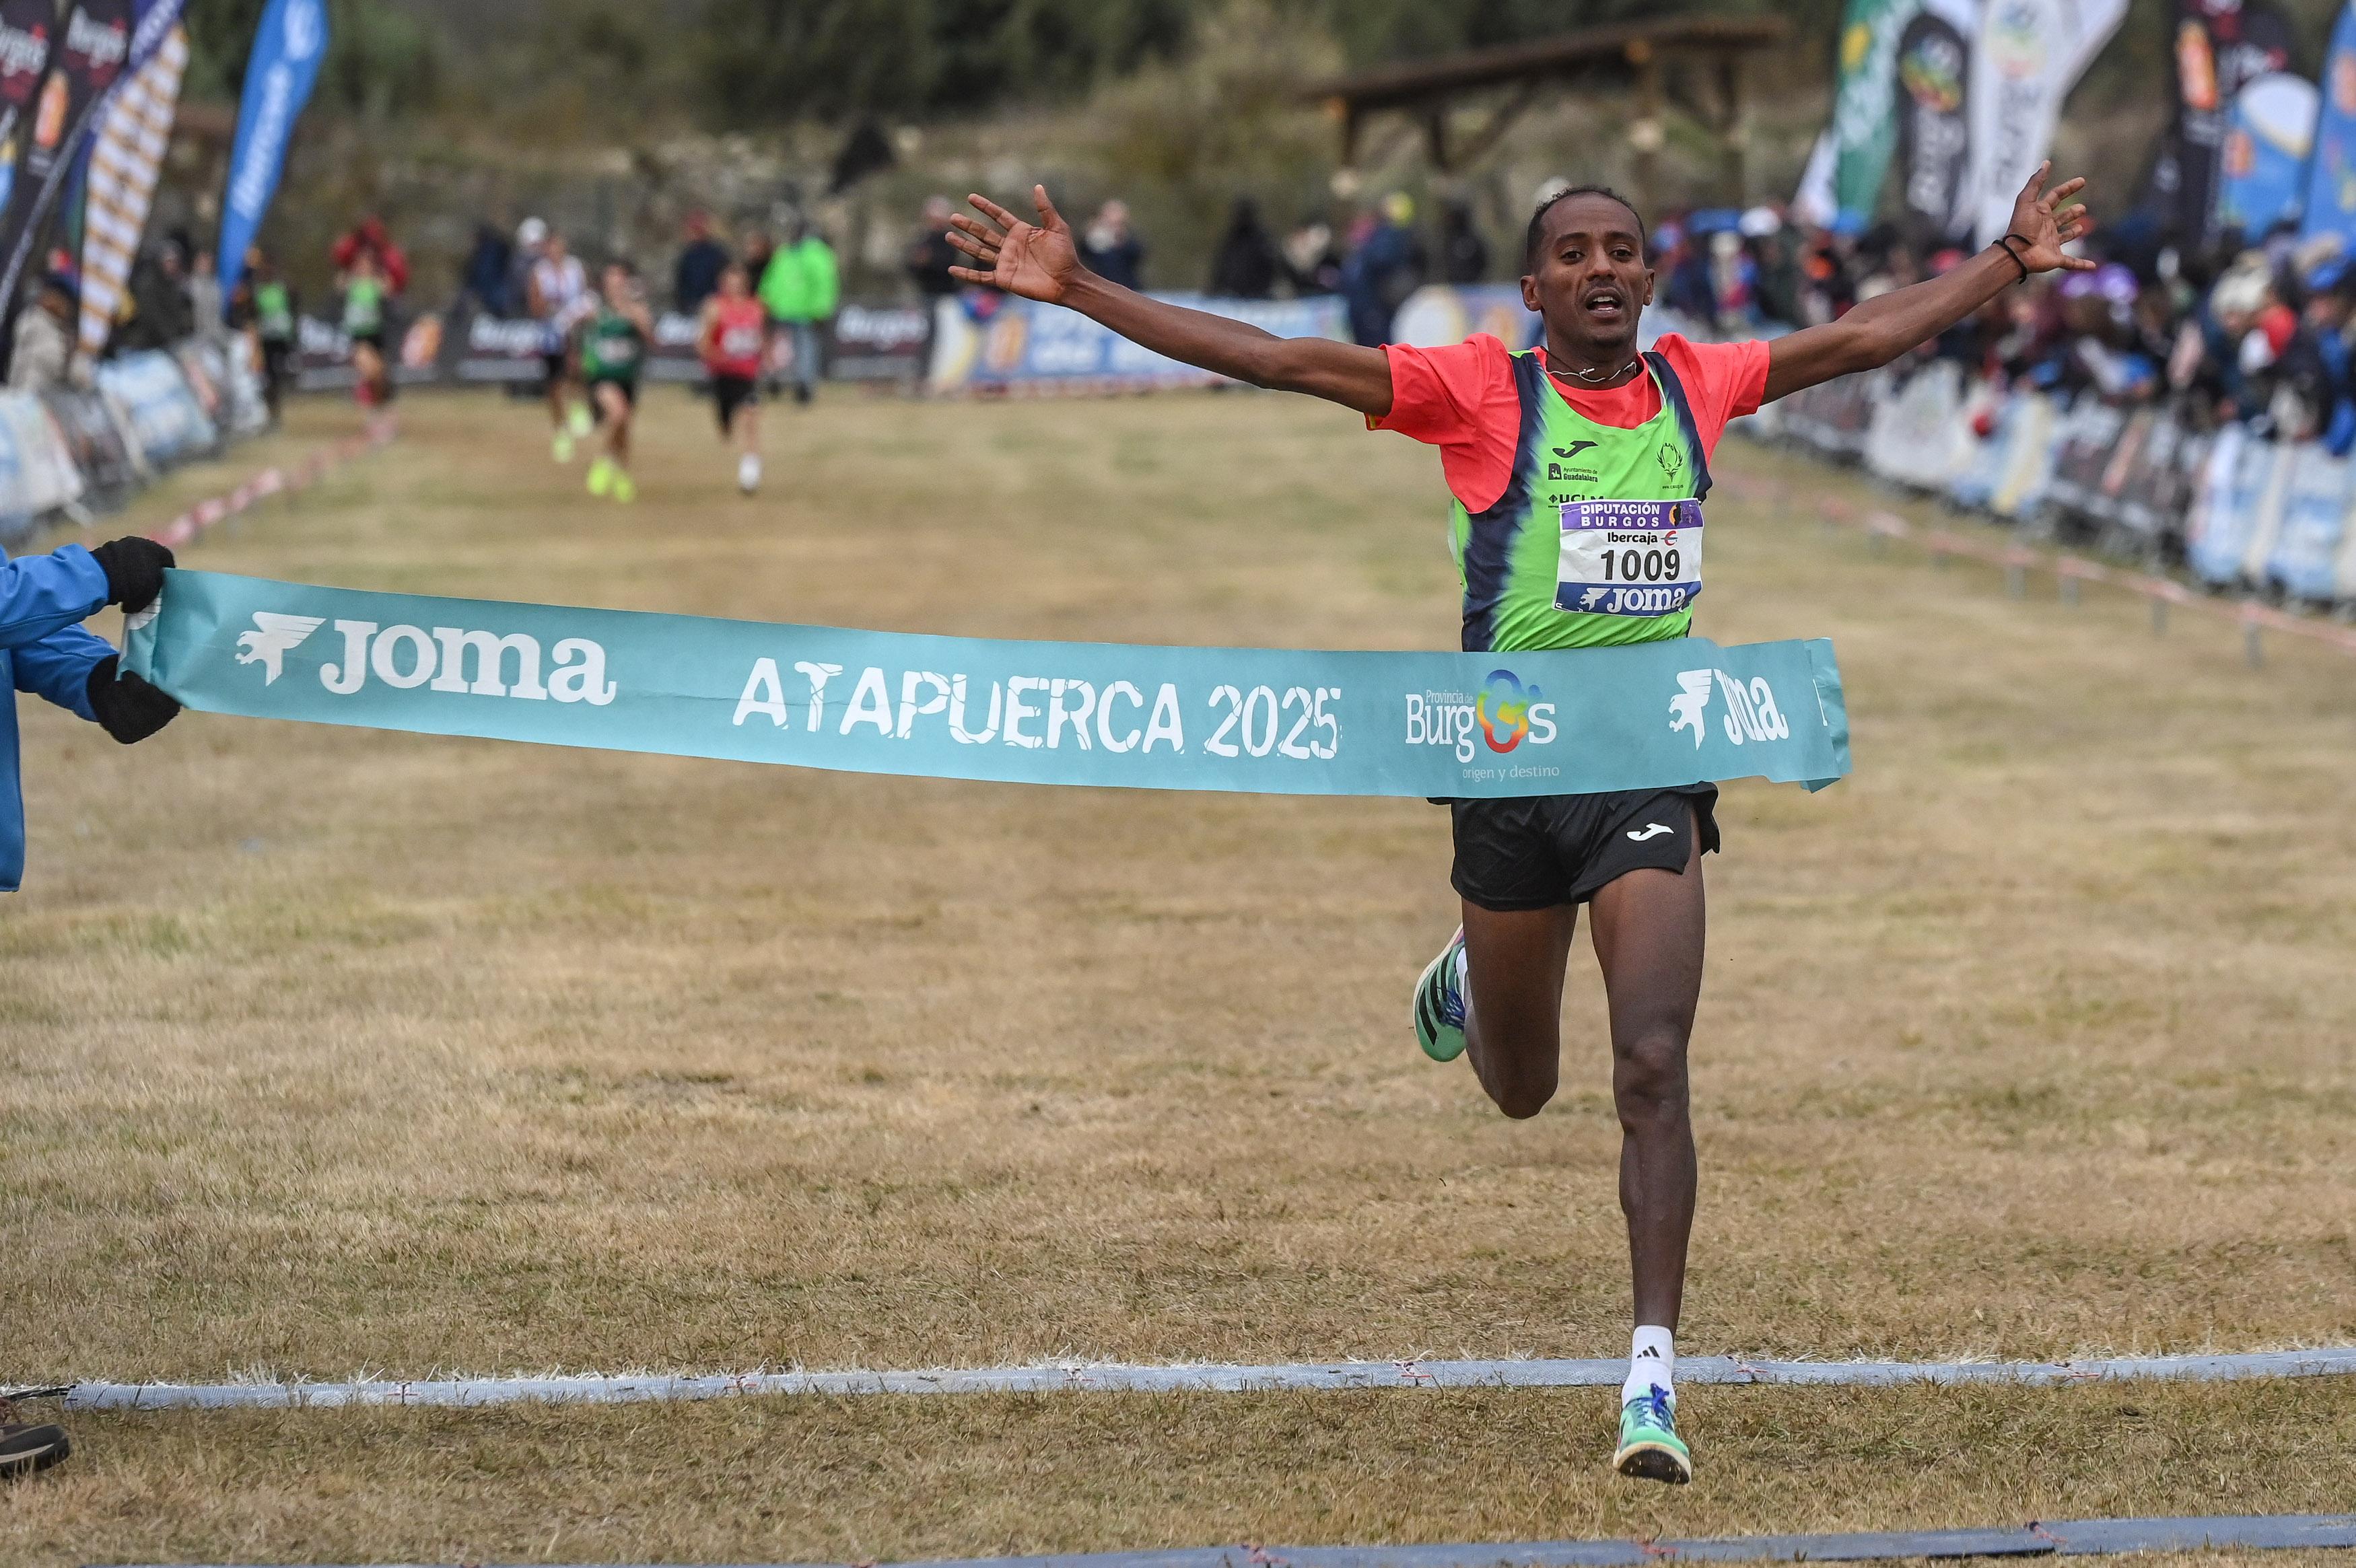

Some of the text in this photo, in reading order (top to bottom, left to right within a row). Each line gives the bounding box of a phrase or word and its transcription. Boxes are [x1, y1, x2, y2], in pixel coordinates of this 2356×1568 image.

[1563, 473, 1598, 483] Guadalajara
[1581, 502, 1660, 515] DIPUTACIÓN
[1581, 516, 1659, 528] BURGOS
[1607, 532, 1658, 545] Ibercaja
[1600, 548, 1680, 581] 1009
[1426, 689, 1474, 705] Provincia de
[732, 657, 1343, 760] ATAPUERCA 2025
[1462, 764, 1560, 783] origen y destino
